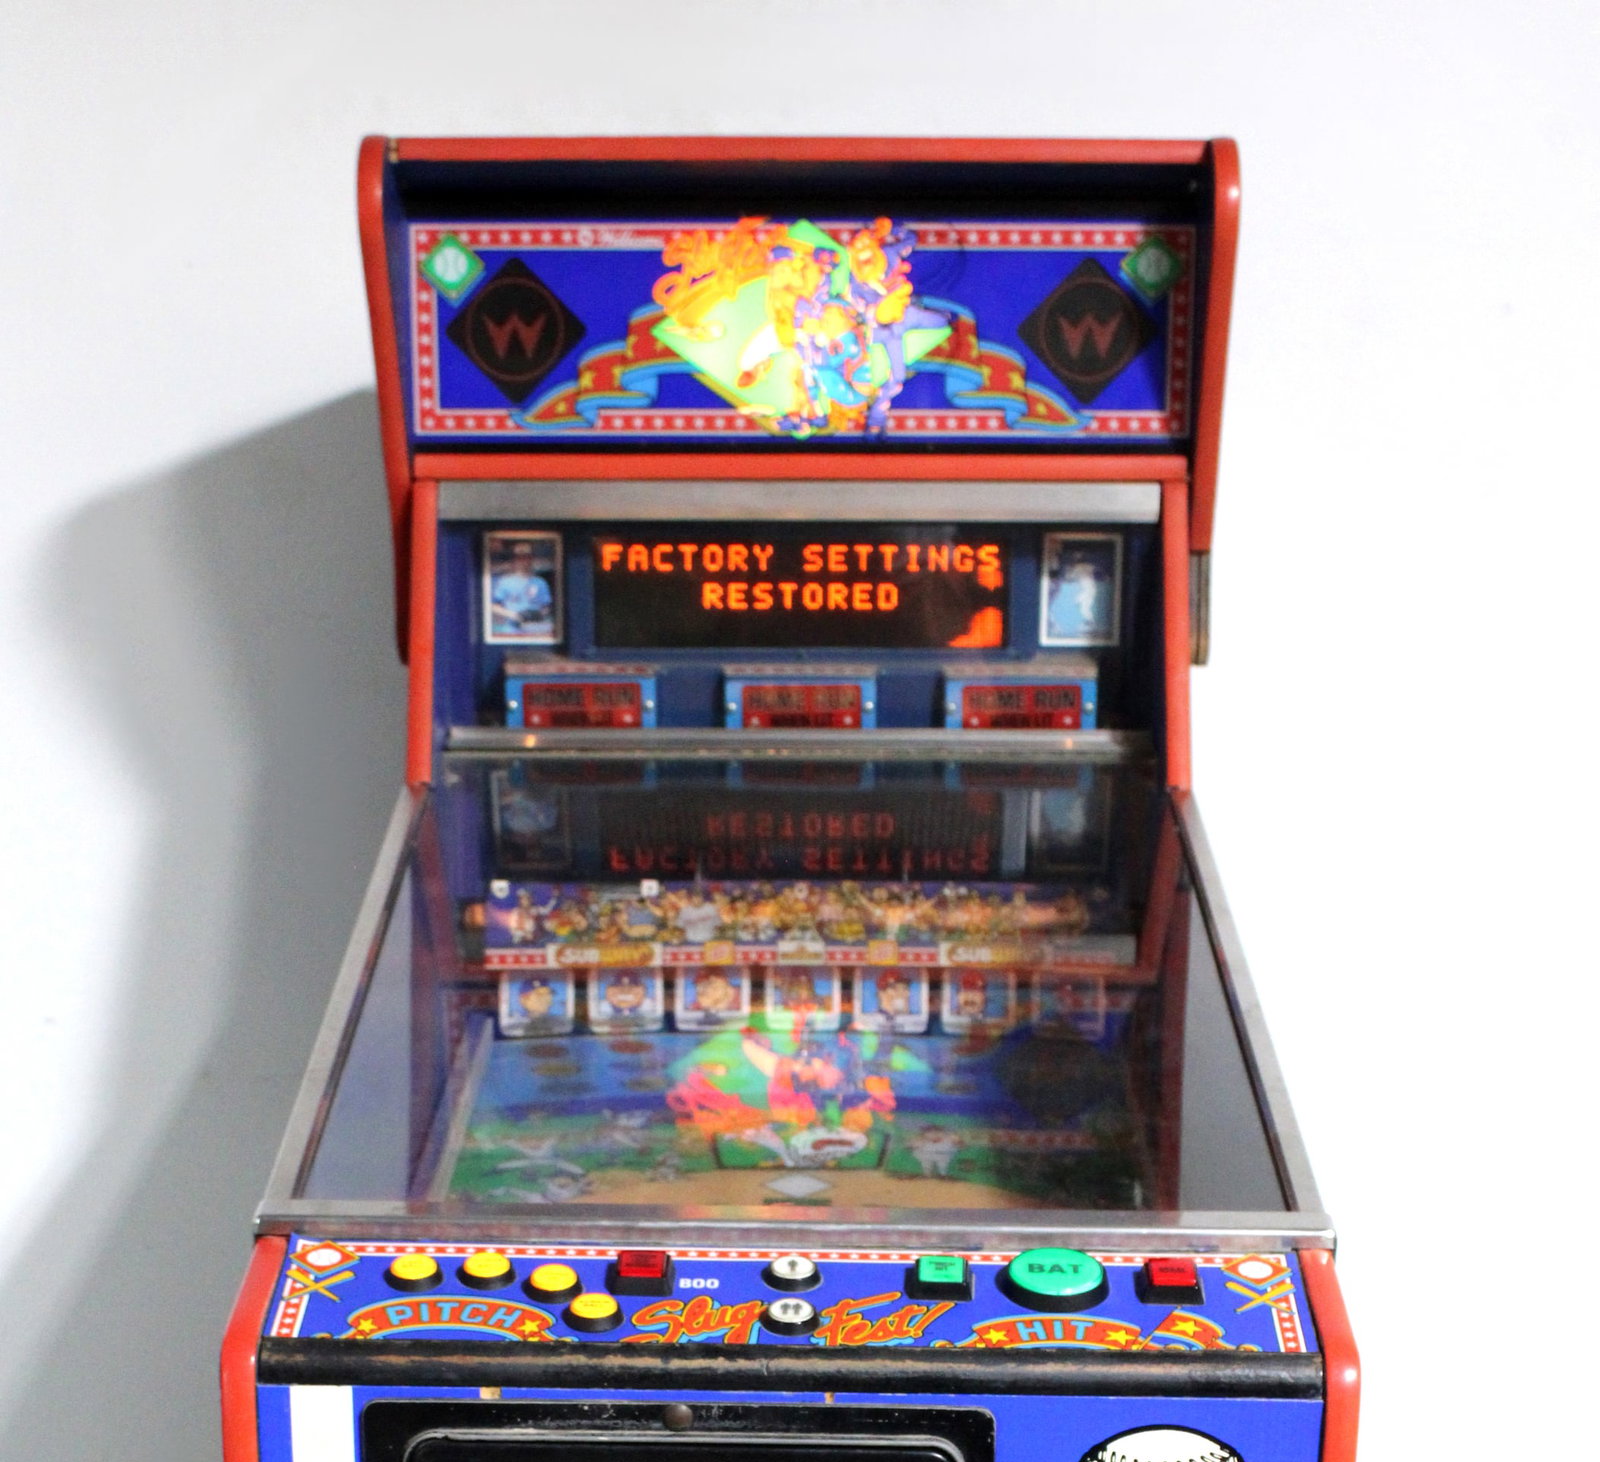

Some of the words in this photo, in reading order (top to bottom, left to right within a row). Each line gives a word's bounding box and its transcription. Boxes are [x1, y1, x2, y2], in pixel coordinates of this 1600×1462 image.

[602, 544, 774, 572] FACTORY
[802, 544, 1001, 572] SETTINGS
[702, 582, 899, 611] RESTORED
[1027, 1263, 1083, 1275] BAT
[679, 1278, 720, 1290] BOO
[385, 1301, 523, 1329] PITCH
[631, 1295, 768, 1344] Slug
[1015, 1320, 1095, 1342] HIT
